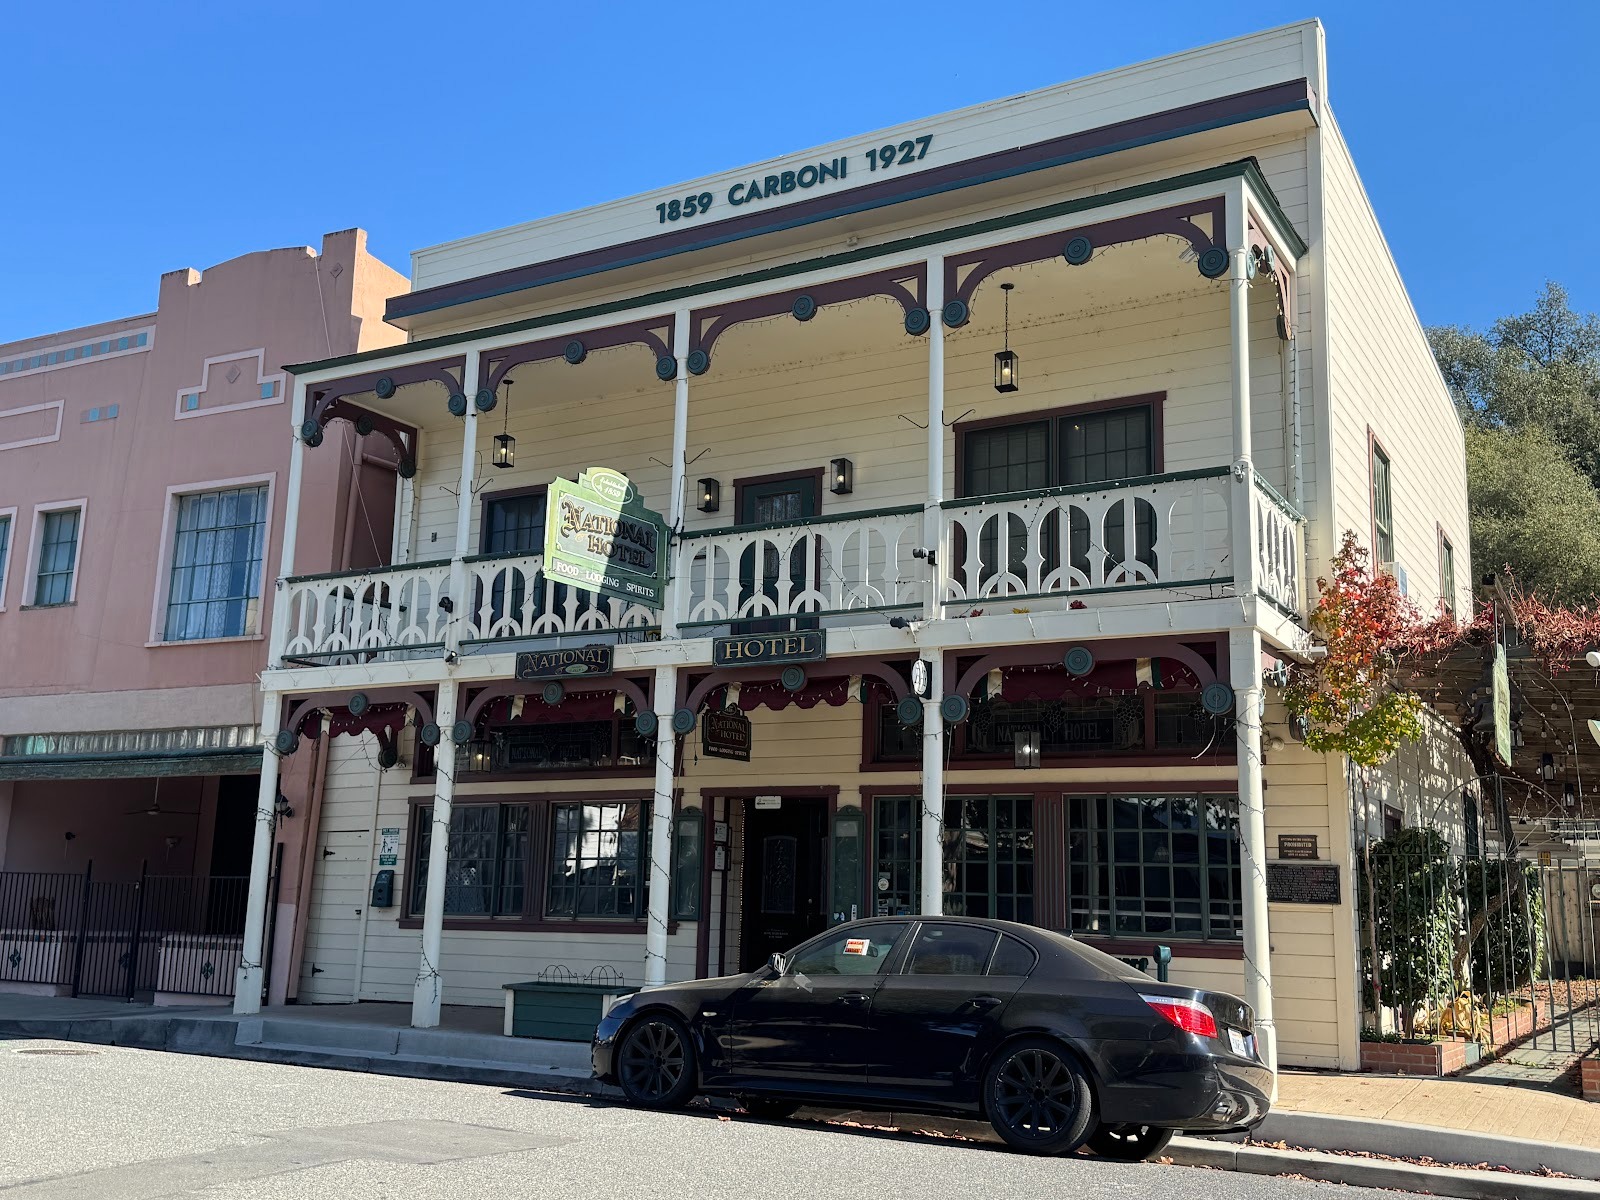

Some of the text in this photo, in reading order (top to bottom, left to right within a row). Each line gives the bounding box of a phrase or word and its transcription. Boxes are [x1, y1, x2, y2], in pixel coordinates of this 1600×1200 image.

[655, 133, 934, 224] 1859 CARBONI 1927
[561, 500, 656, 553] NATIONAL
[587, 534, 650, 569] HOTEL
[555, 561, 655, 598] FOOD LODGING SPIRITS
[524, 636, 815, 672] NATIONAL HOTEL
[708, 716, 746, 733] NATIONAL
[720, 729, 746, 741] HOTEL
[1064, 722, 1102, 741] HOTEL
